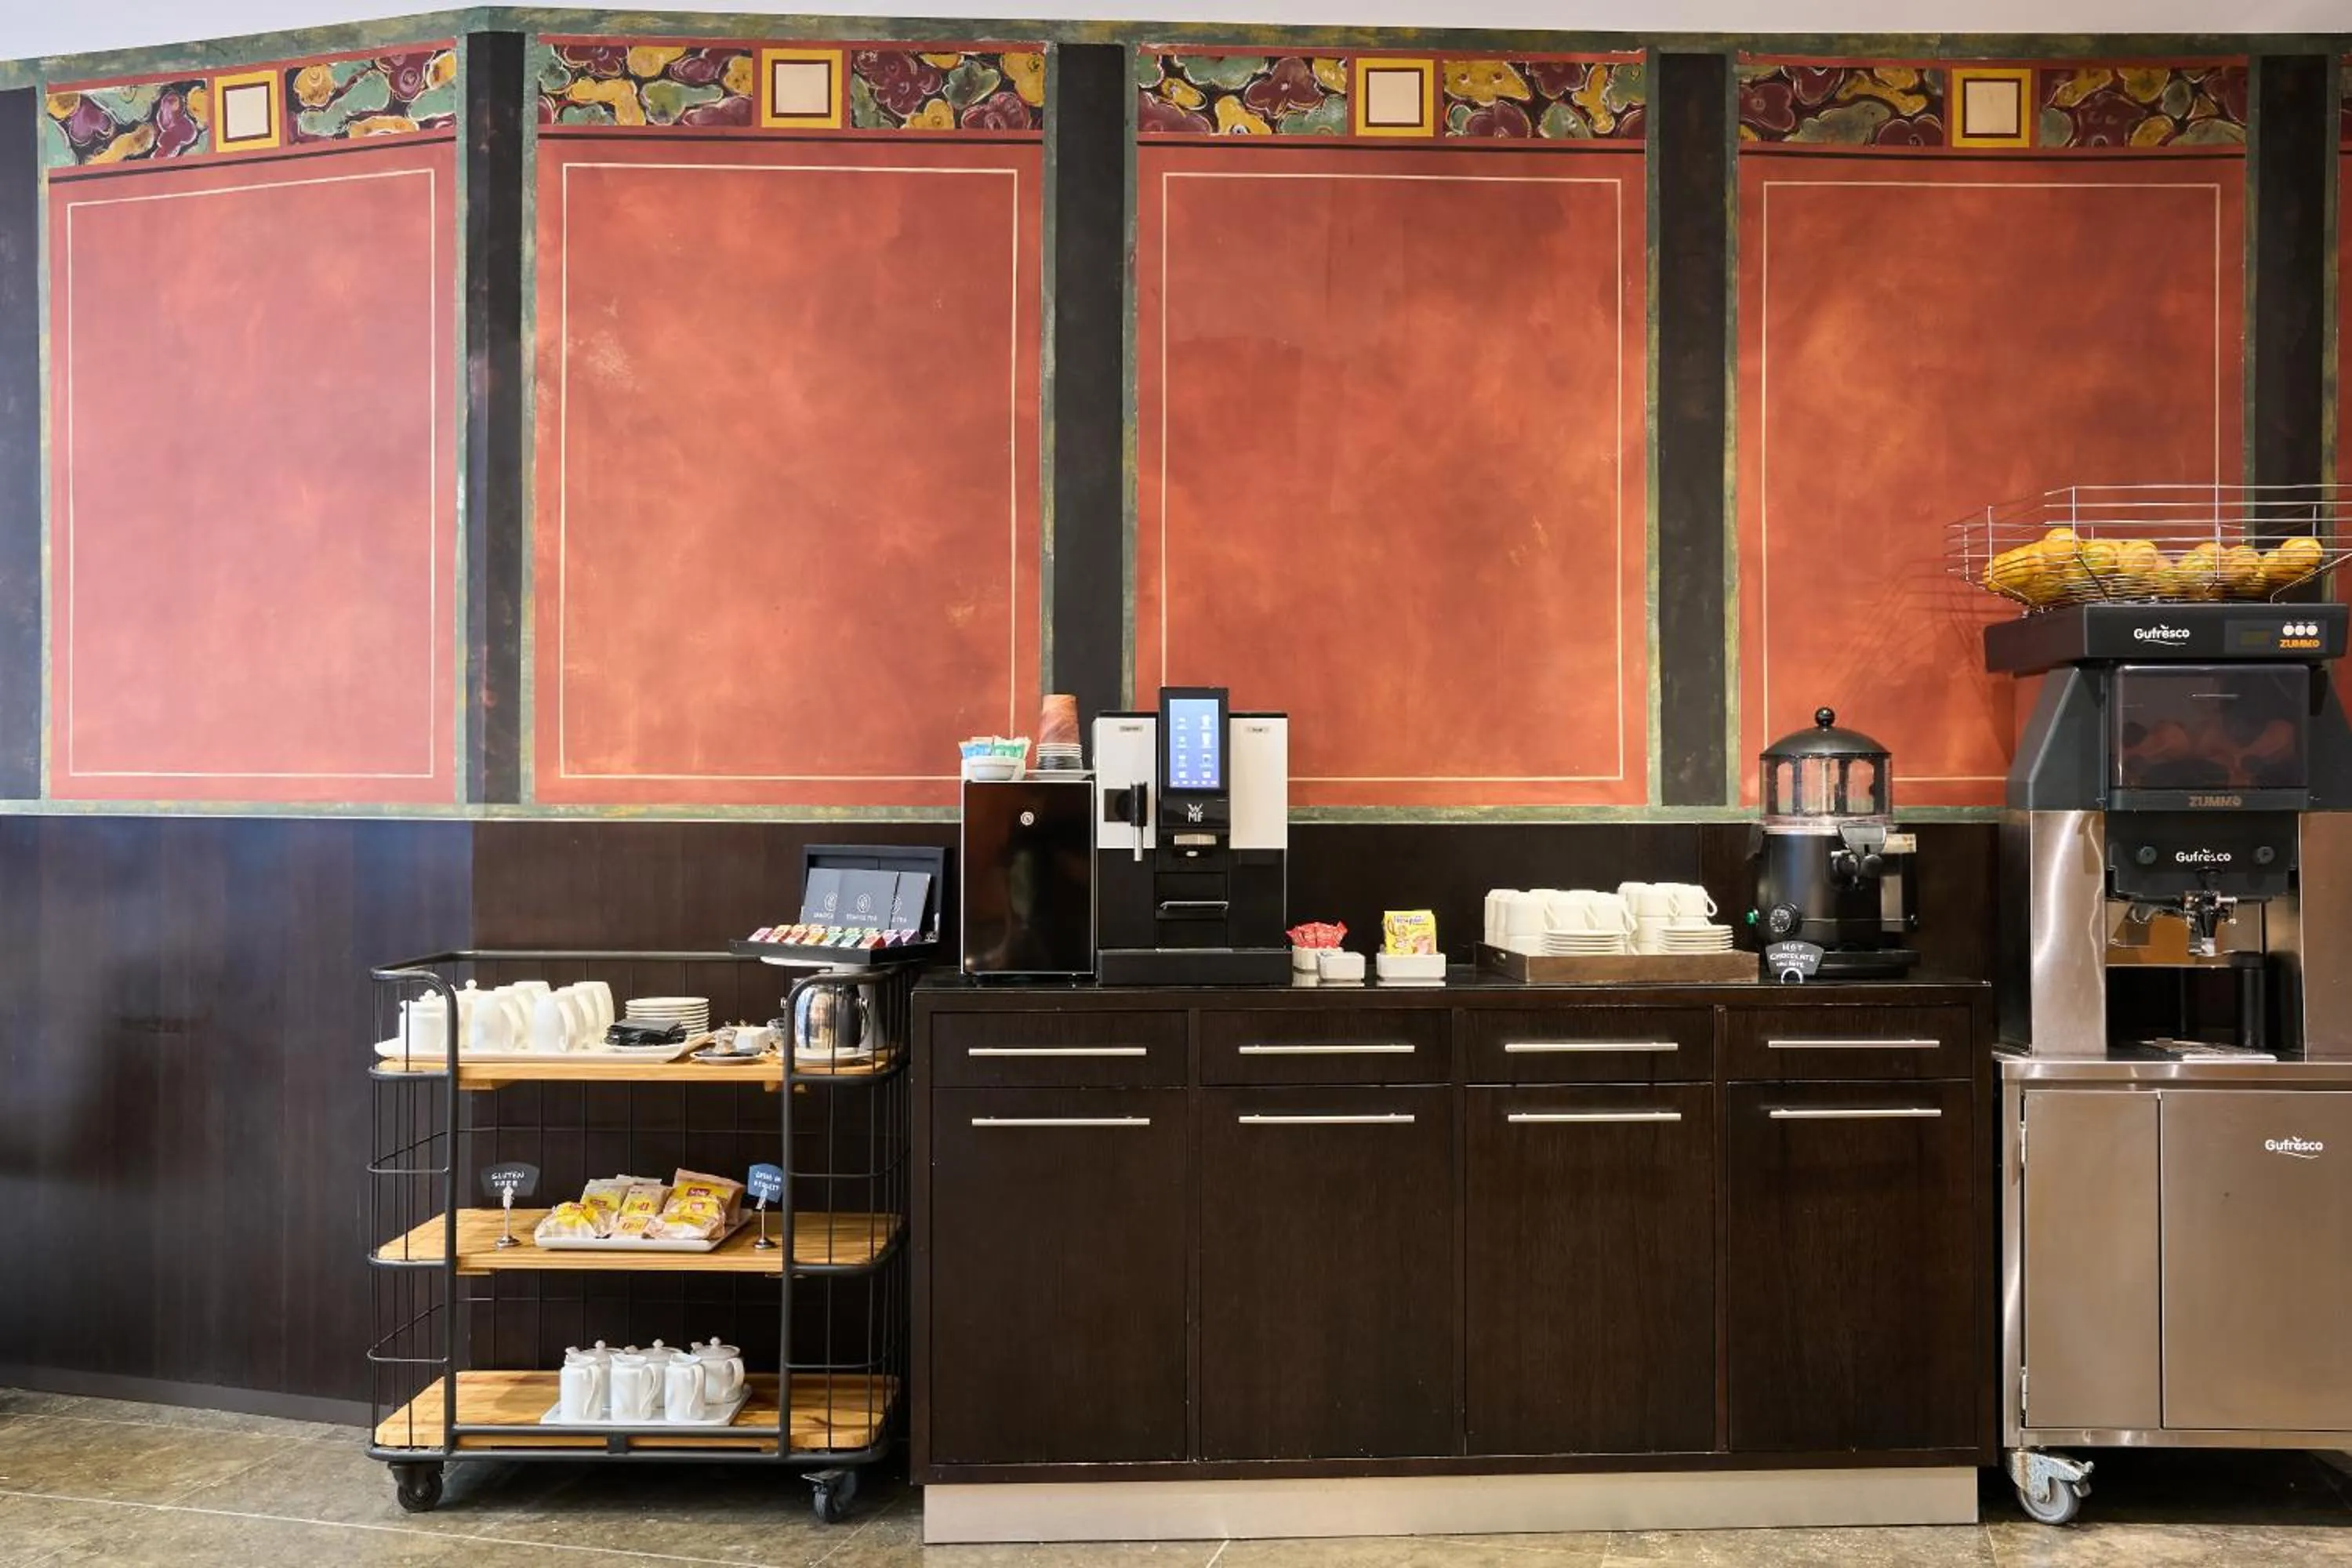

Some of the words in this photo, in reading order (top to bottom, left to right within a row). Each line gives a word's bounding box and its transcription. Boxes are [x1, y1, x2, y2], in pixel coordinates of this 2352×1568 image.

[2133, 624, 2190, 639] Gufresco
[2279, 639, 2321, 648] ZUMMO
[2189, 795, 2241, 807] ZUMMO
[2176, 848, 2231, 862] Gufresco
[1782, 943, 1804, 952] HOT
[2265, 1136, 2323, 1151] Gufresco
